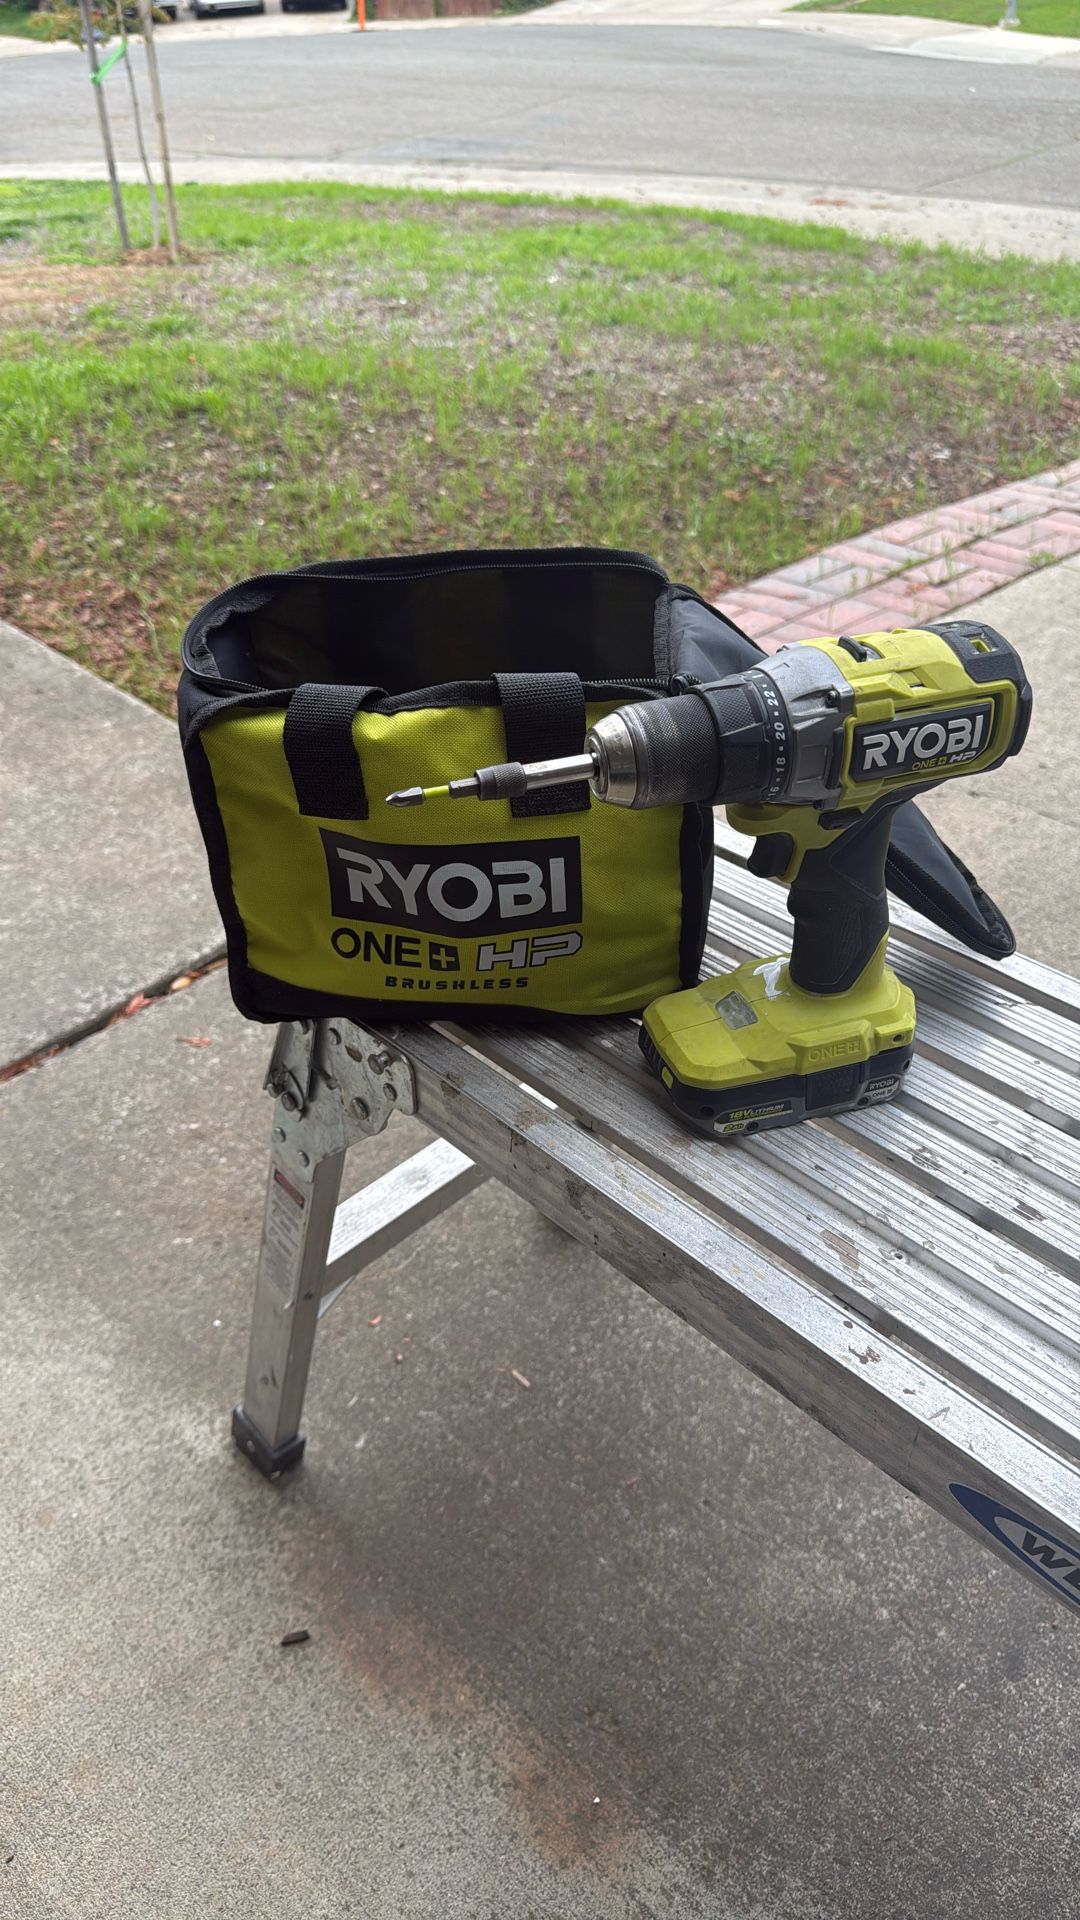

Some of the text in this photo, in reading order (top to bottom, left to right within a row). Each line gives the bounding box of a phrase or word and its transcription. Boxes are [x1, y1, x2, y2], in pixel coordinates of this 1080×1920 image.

[764, 690, 779, 707] 22
[774, 722, 786, 741] 20
[863, 714, 984, 770] RYOBI
[775, 757, 787, 773] 18
[949, 750, 977, 763] HP
[336, 847, 567, 922] RYOBI
[476, 930, 583, 972] HP
[385, 975, 529, 990] BRUSHLESS
[870, 1077, 894, 1090] RYOBI
